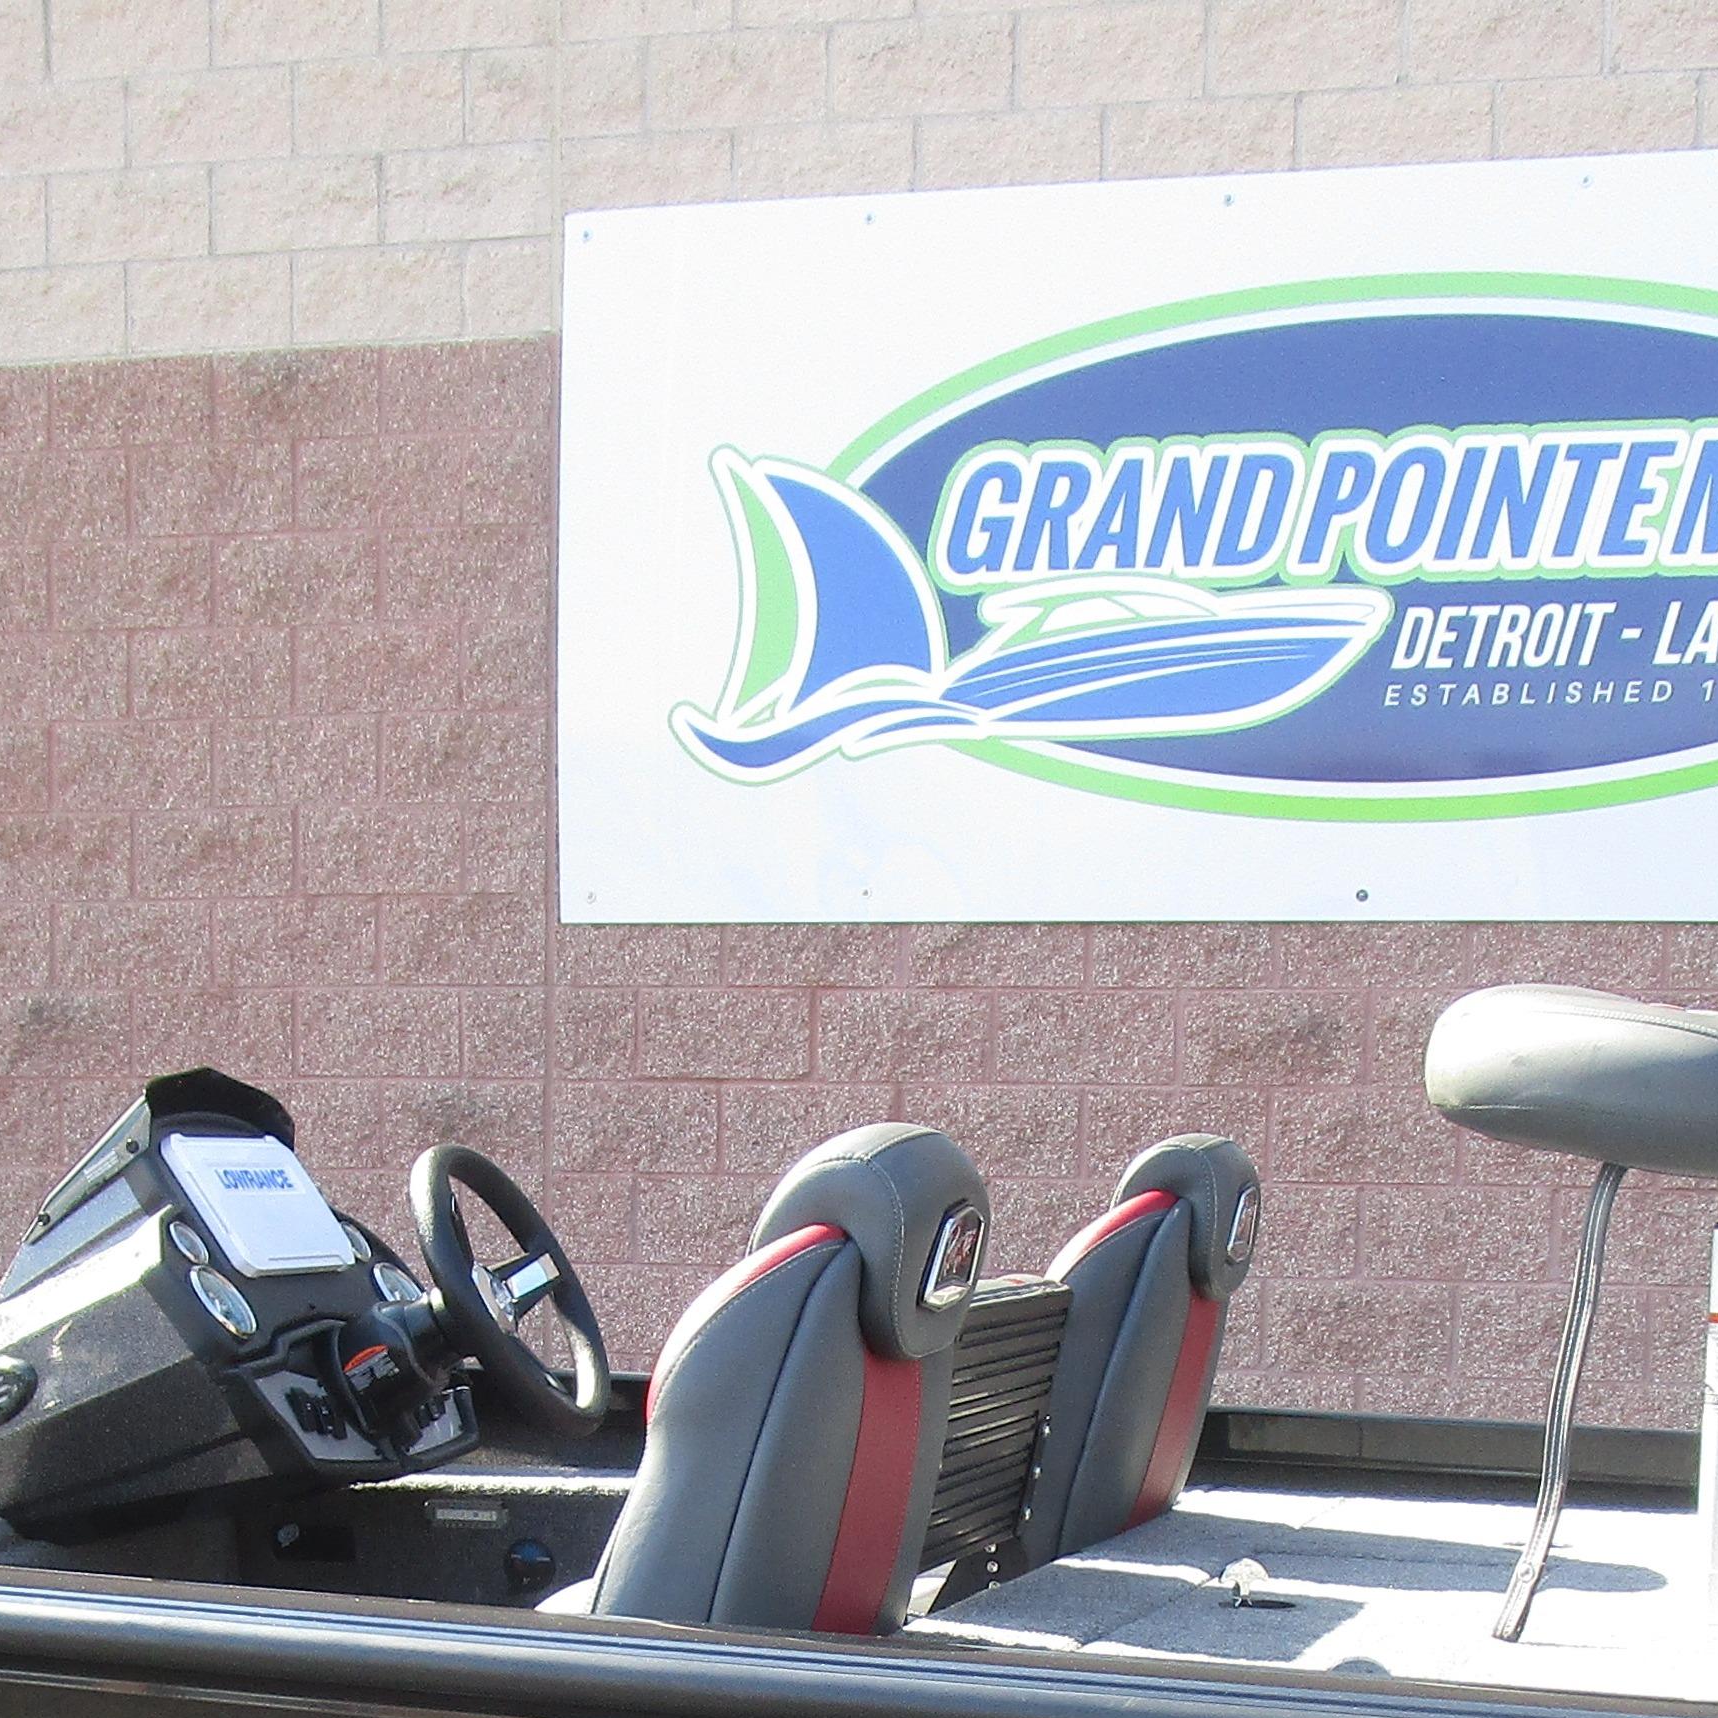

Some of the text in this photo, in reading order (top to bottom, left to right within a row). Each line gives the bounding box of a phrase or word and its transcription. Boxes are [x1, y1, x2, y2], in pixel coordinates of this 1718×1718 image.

[943, 448, 1293, 576] GRAND
[1295, 439, 1684, 567] POINTE
[1389, 602, 1618, 670] DETROIT
[1384, 679, 1674, 707] ESTABLISHED
[215, 1168, 294, 1190] LOWRANCE
